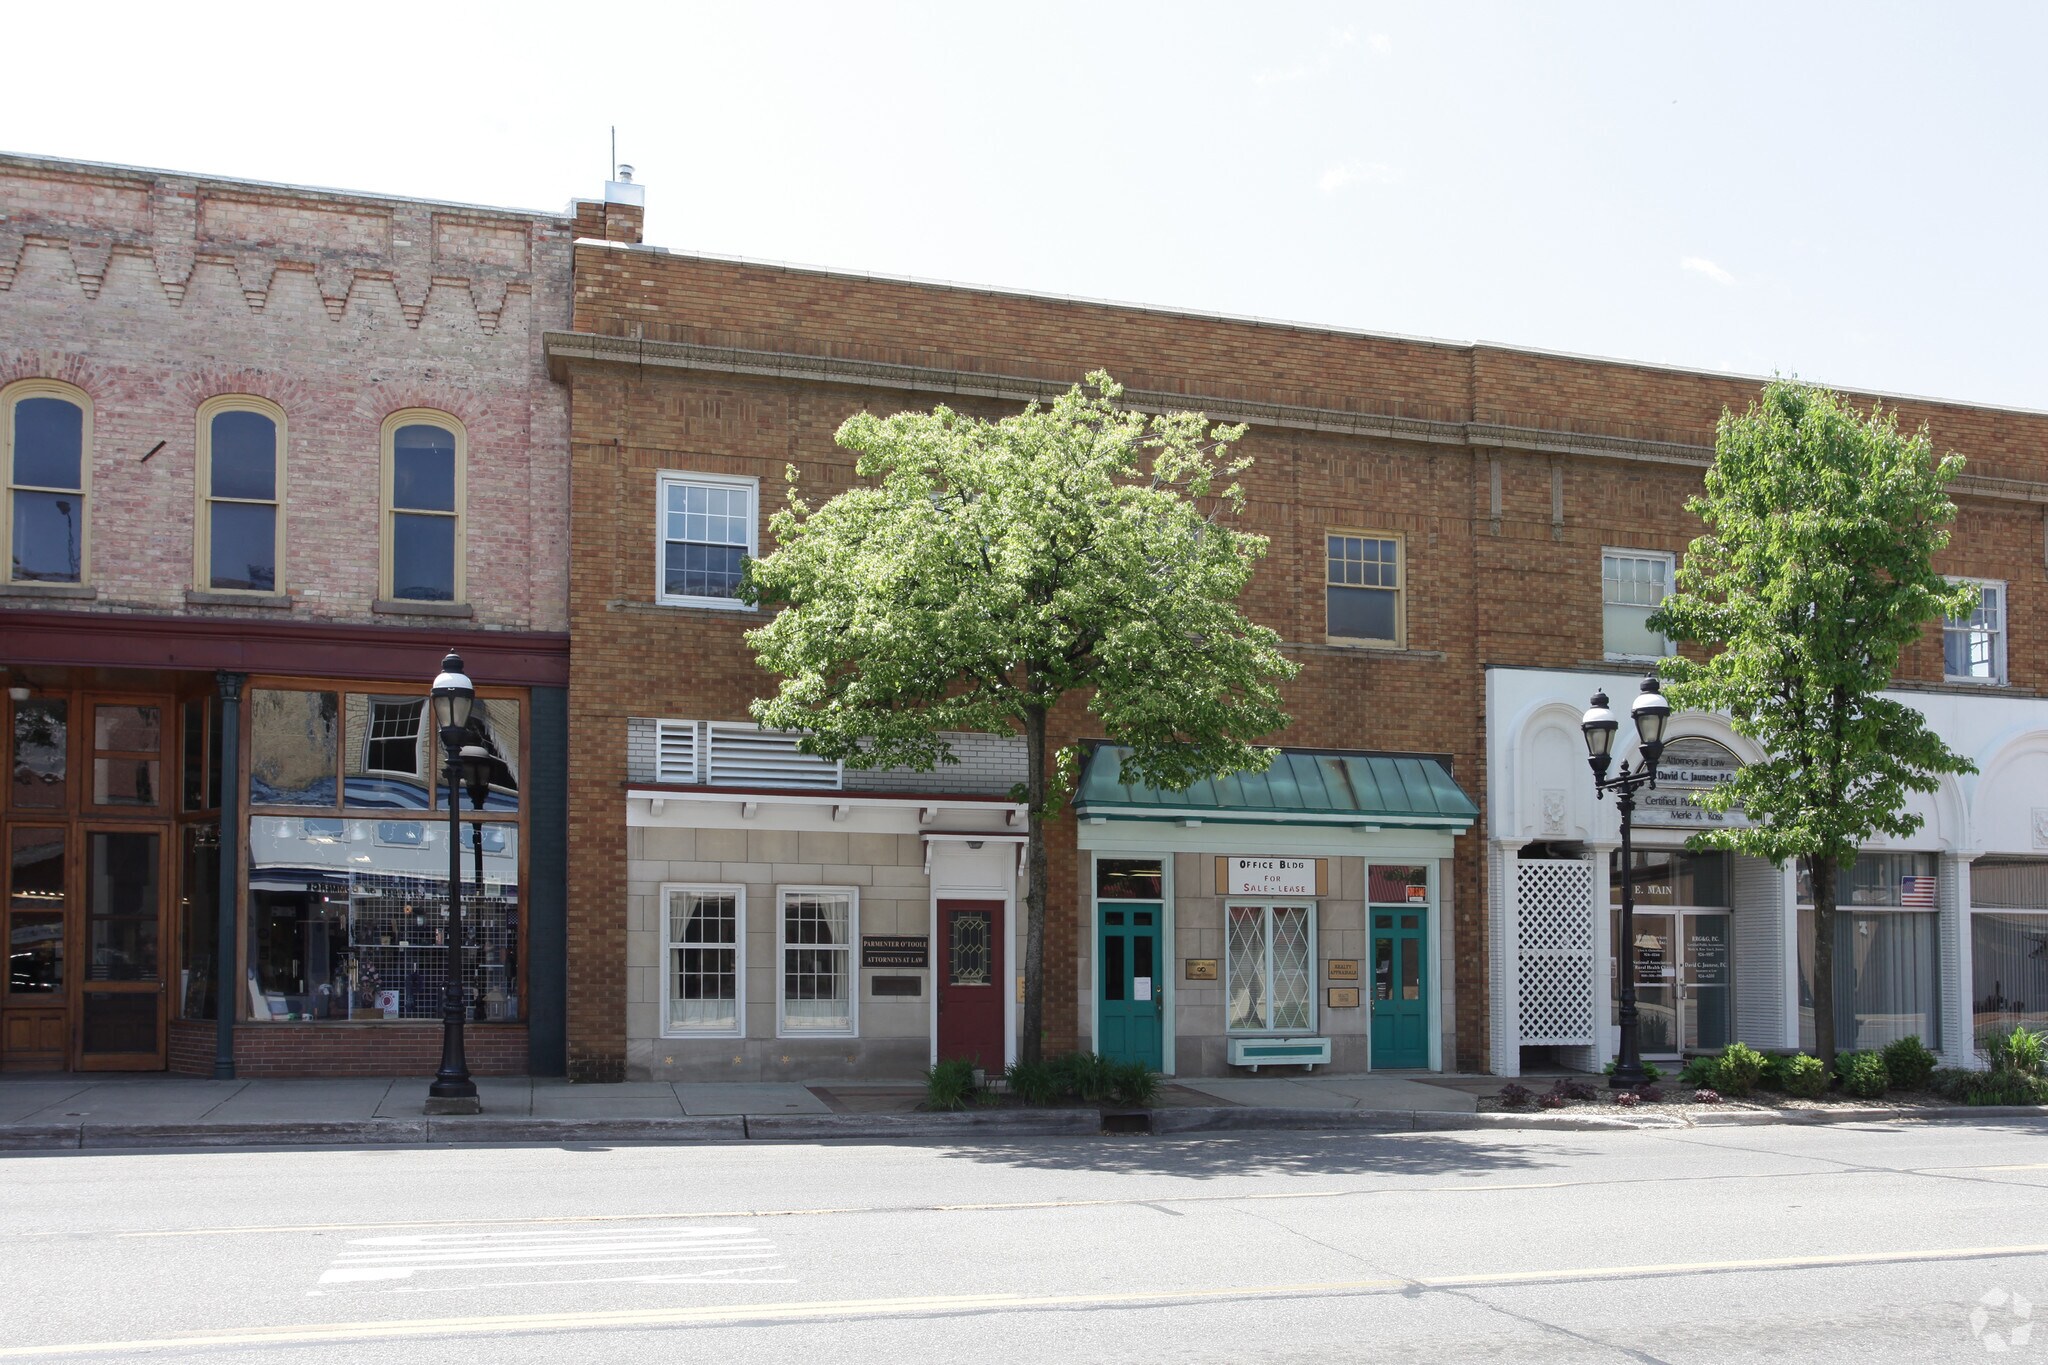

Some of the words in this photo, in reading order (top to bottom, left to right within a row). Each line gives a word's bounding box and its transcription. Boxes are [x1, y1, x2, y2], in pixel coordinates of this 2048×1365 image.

[1666, 756, 1699, 767] Attorneys
[1702, 758, 1709, 767] at
[1711, 759, 1726, 767] Law
[1658, 771, 1679, 781] David
[1681, 772, 1689, 781] C.
[1691, 773, 1718, 783] Jaunese
[1646, 796, 1677, 806] Certified
[1671, 811, 1692, 820] Merle
[1708, 812, 1724, 821] Ross
[1240, 860, 1273, 869] OFFICE
[1280, 860, 1304, 869] BLDG
[1244, 883, 1269, 892] SALE
[1279, 885, 1306, 893] LEASE
[1635, 885, 1644, 894] E.
[1648, 886, 1672, 894] MAIN
[863, 940, 899, 948] PARMENTER
